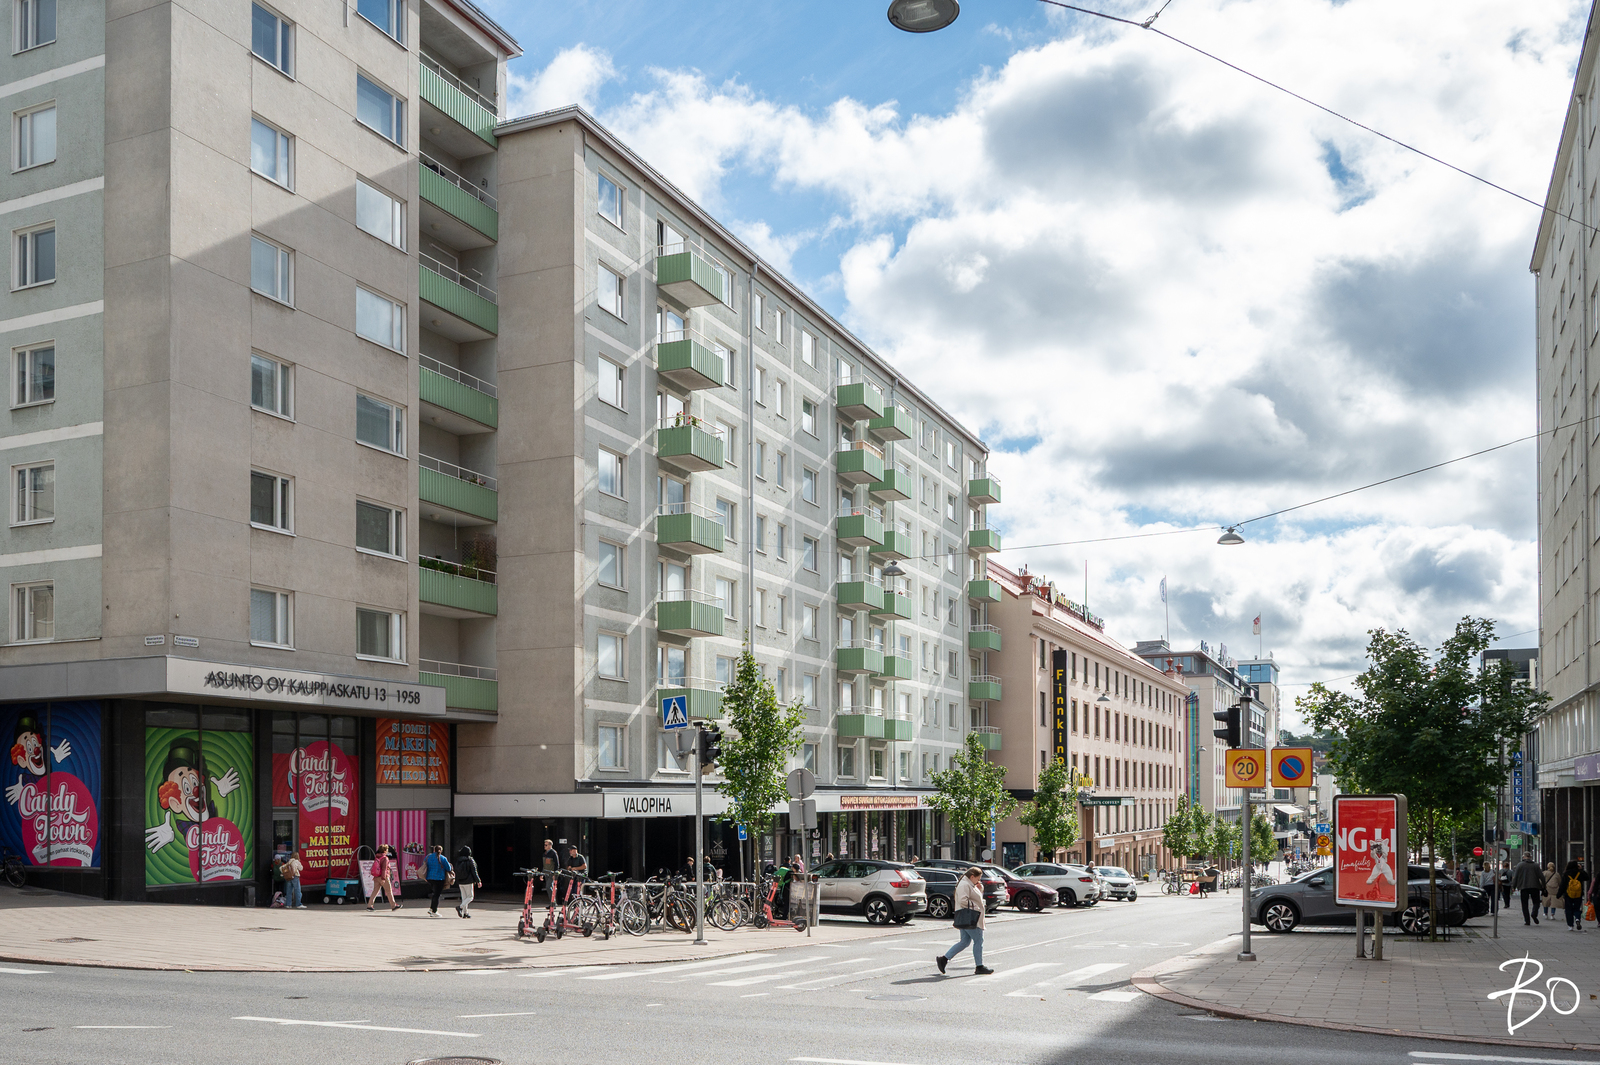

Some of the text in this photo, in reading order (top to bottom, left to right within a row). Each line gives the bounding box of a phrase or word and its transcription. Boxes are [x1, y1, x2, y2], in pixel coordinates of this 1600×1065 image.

[207, 670, 421, 705] ASUNTO OY KAUPPIASKATU 13 1958
[1056, 669, 1065, 765] Finnkino
[384, 736, 438, 752] MAKEIN
[291, 749, 346, 781] Candy
[1236, 762, 1255, 775] 20
[305, 773, 348, 795] Town
[20, 784, 88, 824] Candy
[622, 797, 673, 814] VALOPIHA
[35, 814, 90, 842] Town
[187, 825, 238, 853] Candy
[314, 825, 346, 834] SUOMEN
[308, 835, 351, 847] MAKEIN
[201, 846, 239, 866] Town
